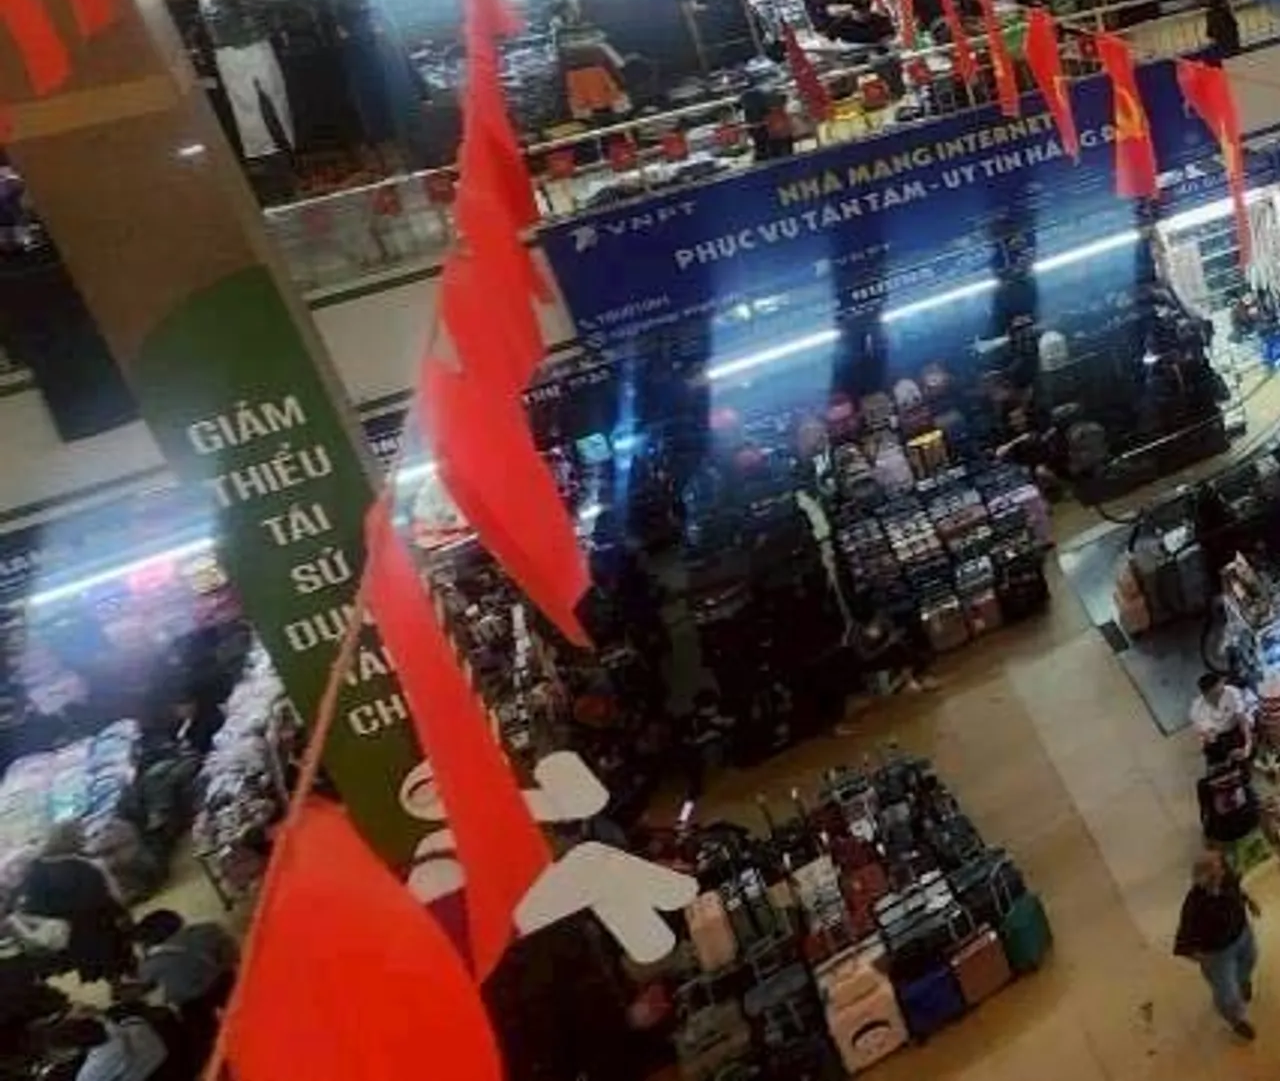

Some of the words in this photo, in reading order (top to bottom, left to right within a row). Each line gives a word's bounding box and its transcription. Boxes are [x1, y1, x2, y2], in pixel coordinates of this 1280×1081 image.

[934, 114, 1056, 163] INTERNET
[605, 201, 698, 236] VNPT
[186, 394, 307, 456] GIẢM
[208, 441, 333, 508] THIỂU
[349, 692, 408, 736] CH
